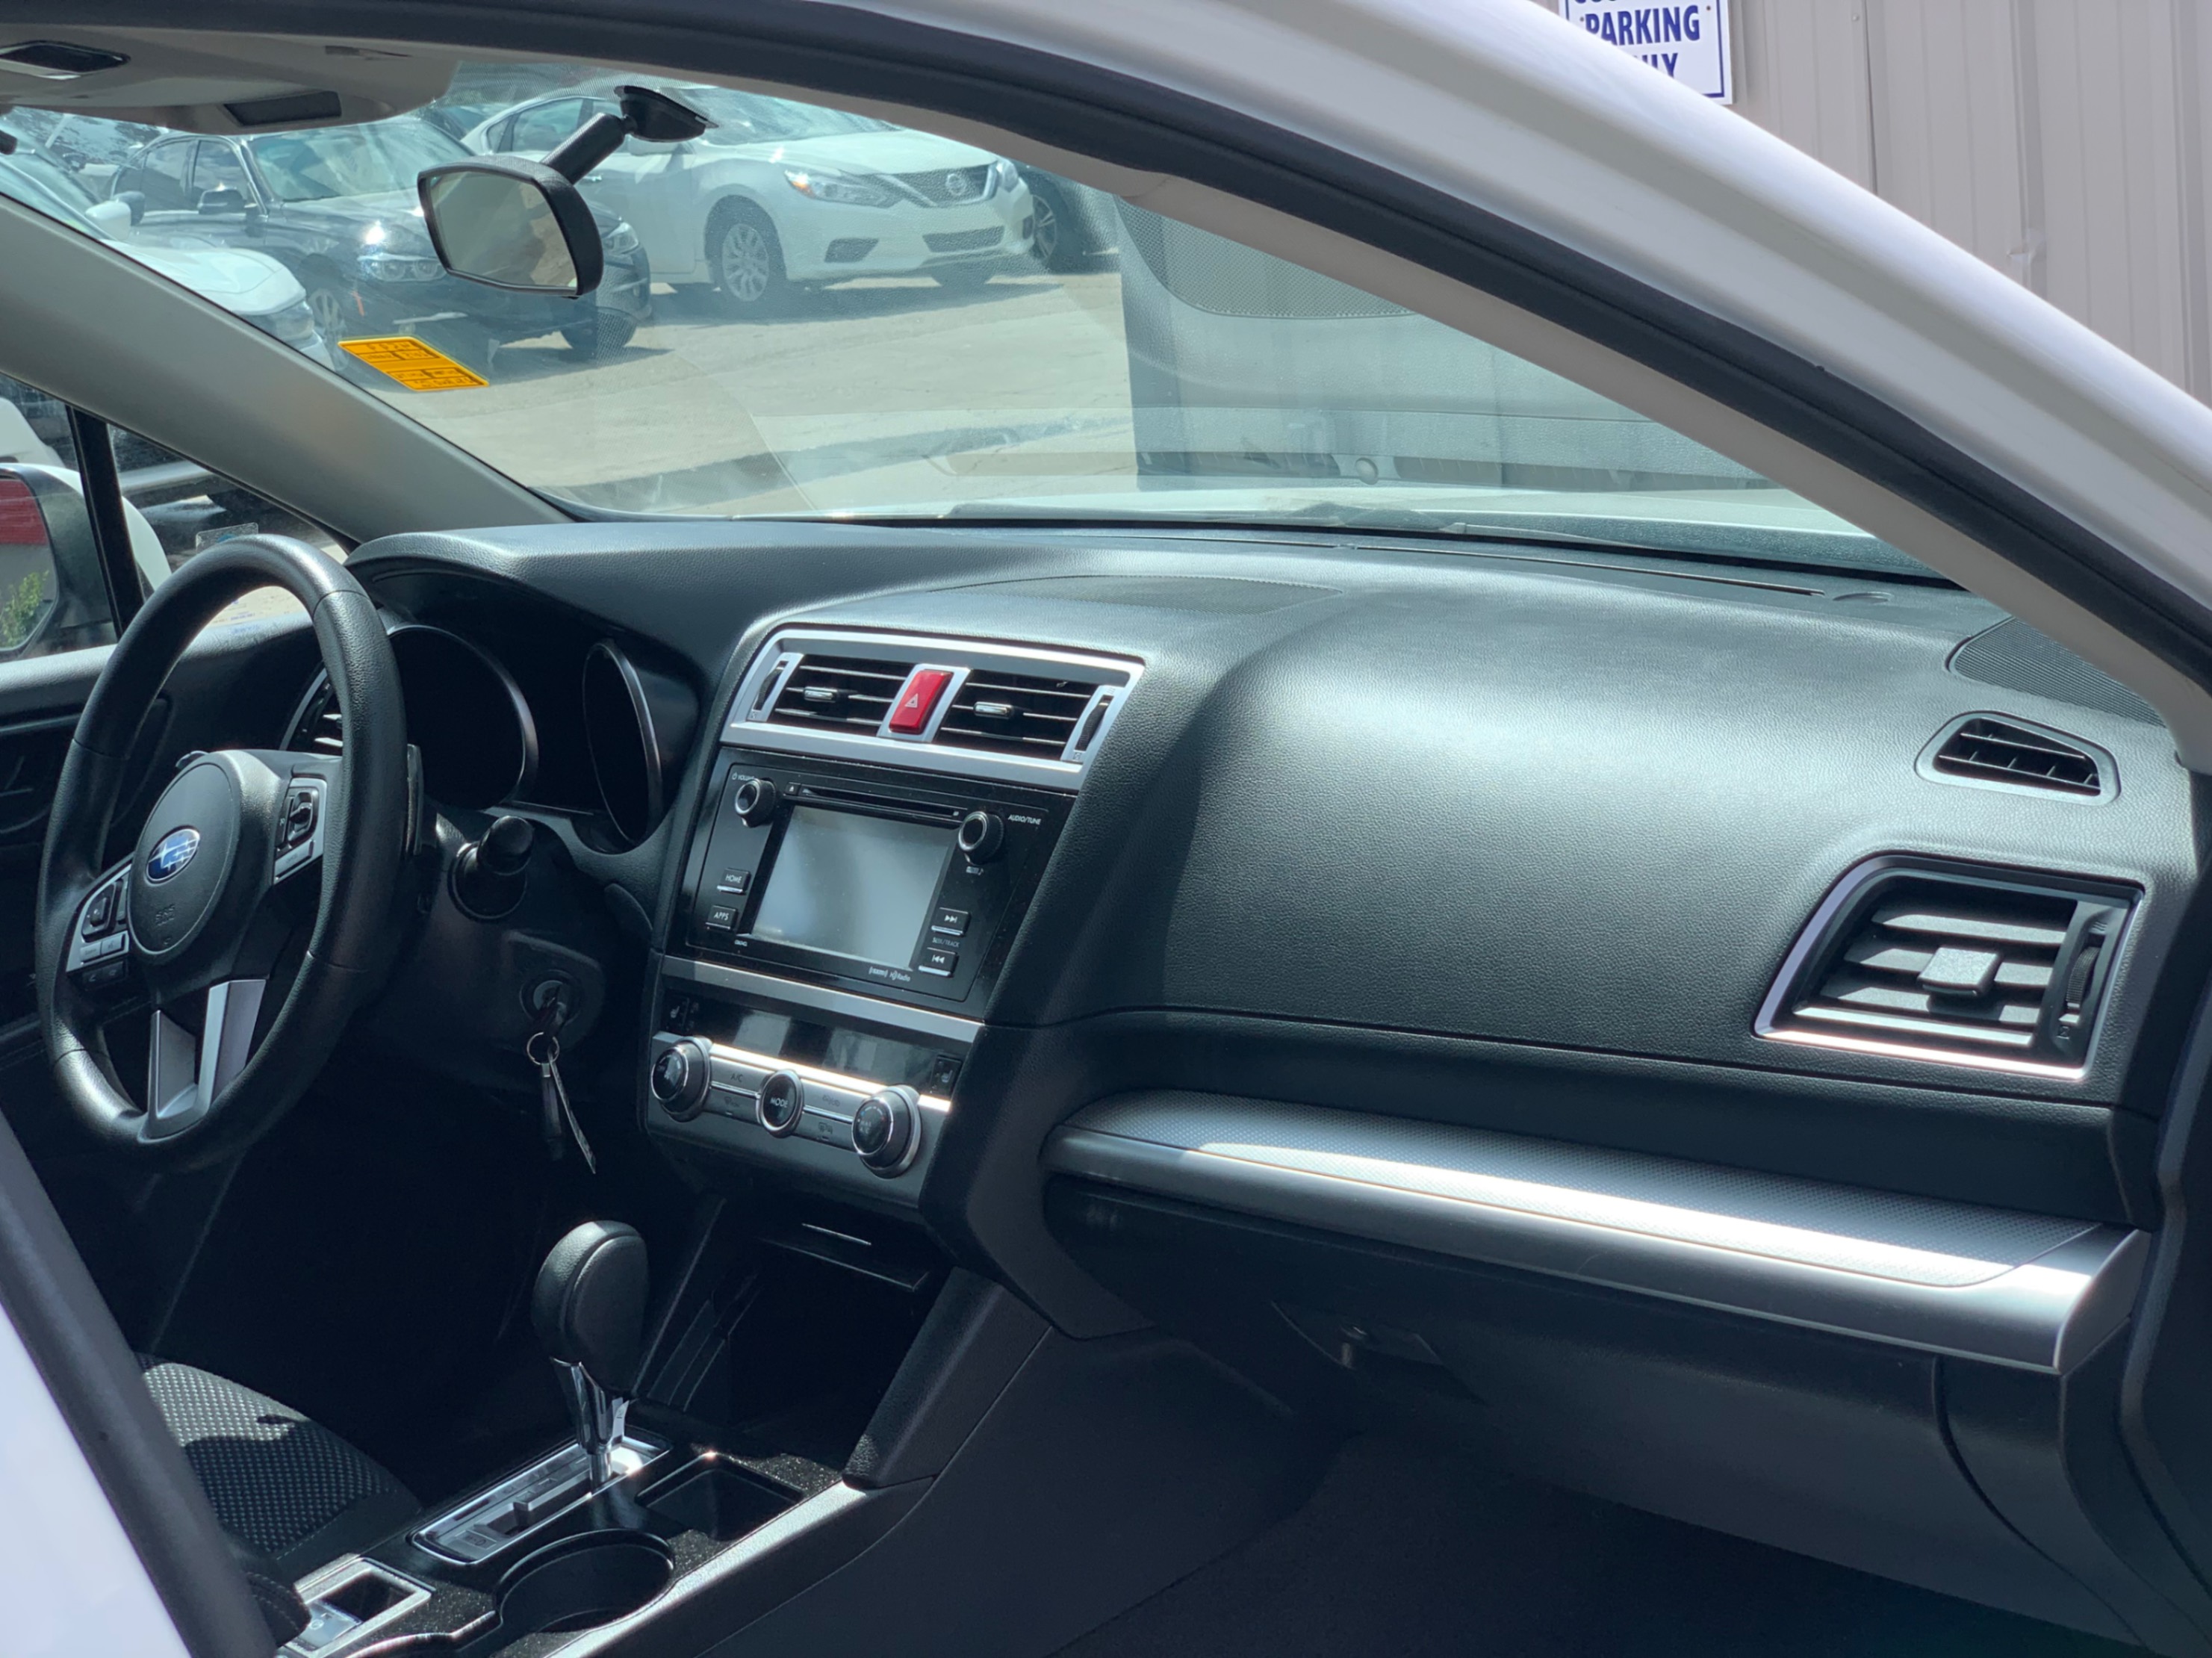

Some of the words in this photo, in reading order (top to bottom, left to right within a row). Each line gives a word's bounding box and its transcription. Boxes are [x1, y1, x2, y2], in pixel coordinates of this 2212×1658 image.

[1585, 5, 1700, 46] PARKING
[1007, 814, 1042, 825] AUDIO/TUNE
[725, 874, 742, 884] HOME
[713, 911, 729, 921] APPS
[730, 1073, 743, 1083] A/C
[770, 1097, 789, 1108] MODE
